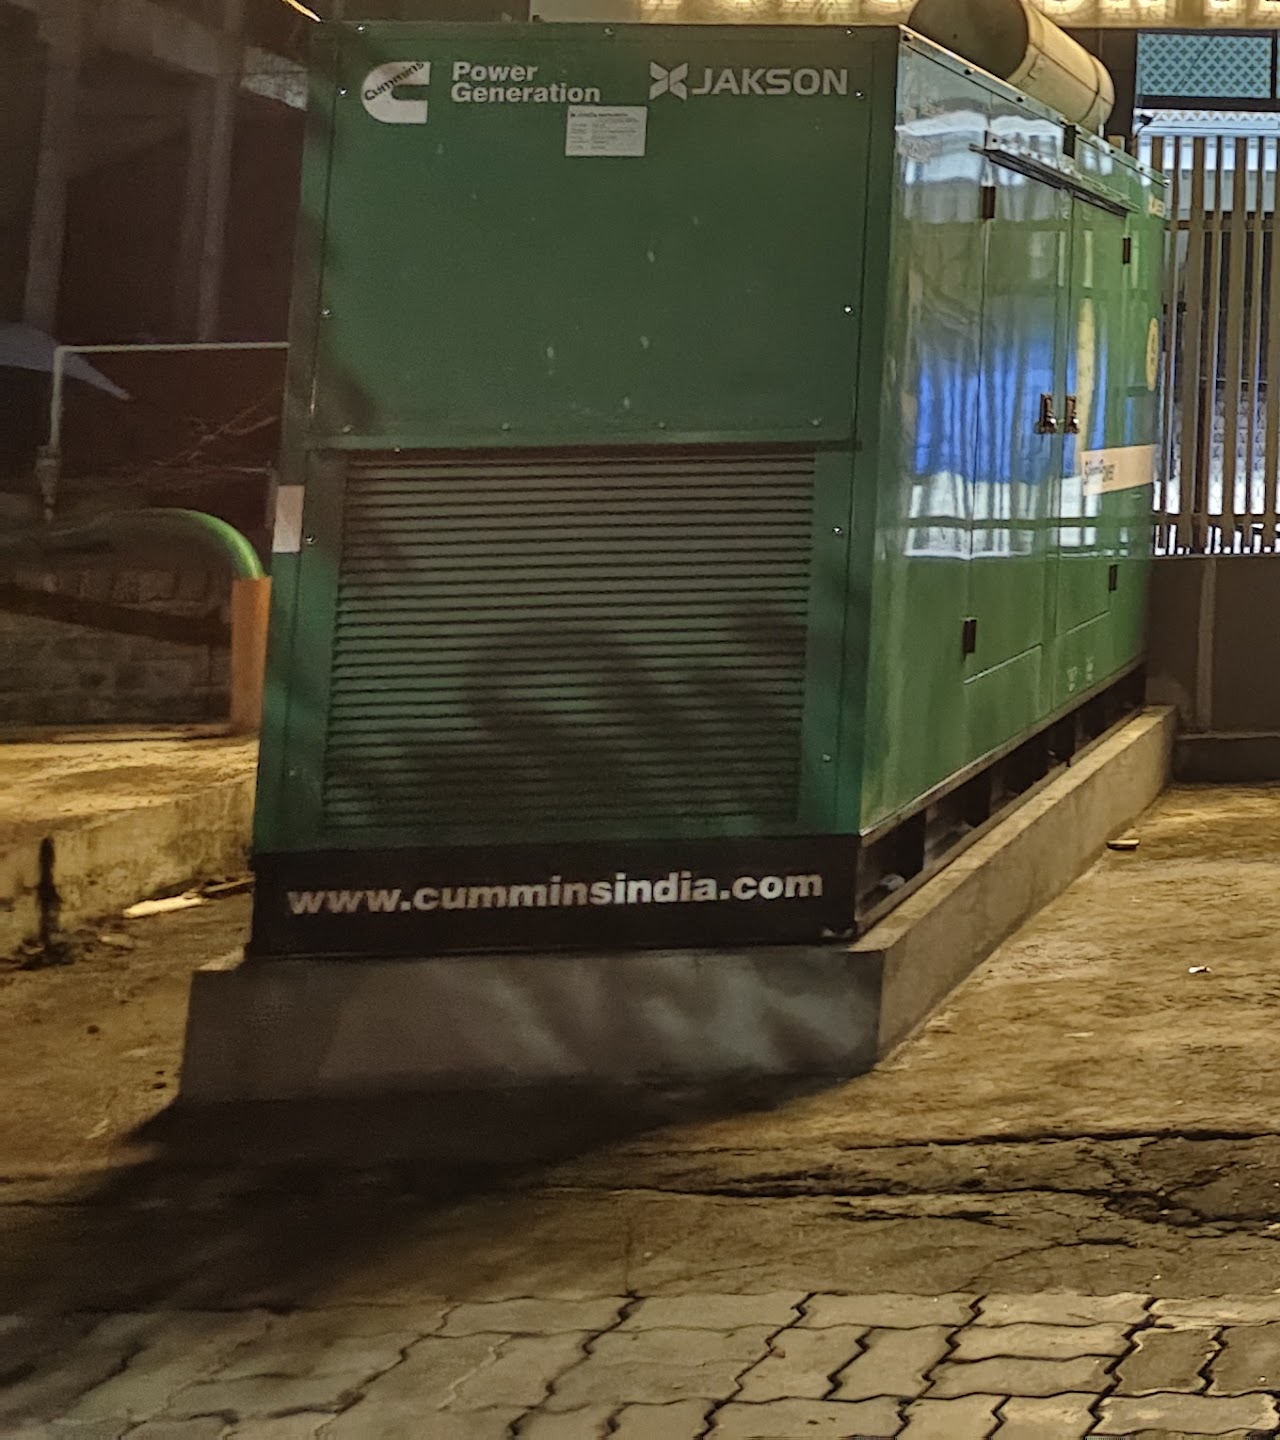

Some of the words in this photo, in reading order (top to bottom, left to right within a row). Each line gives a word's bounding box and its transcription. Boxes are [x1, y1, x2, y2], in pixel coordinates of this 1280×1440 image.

[452, 61, 538, 82] Power
[691, 68, 848, 95] JAKSON
[450, 83, 600, 103] Generation
[286, 871, 823, 915] www.cumminsindia.com
